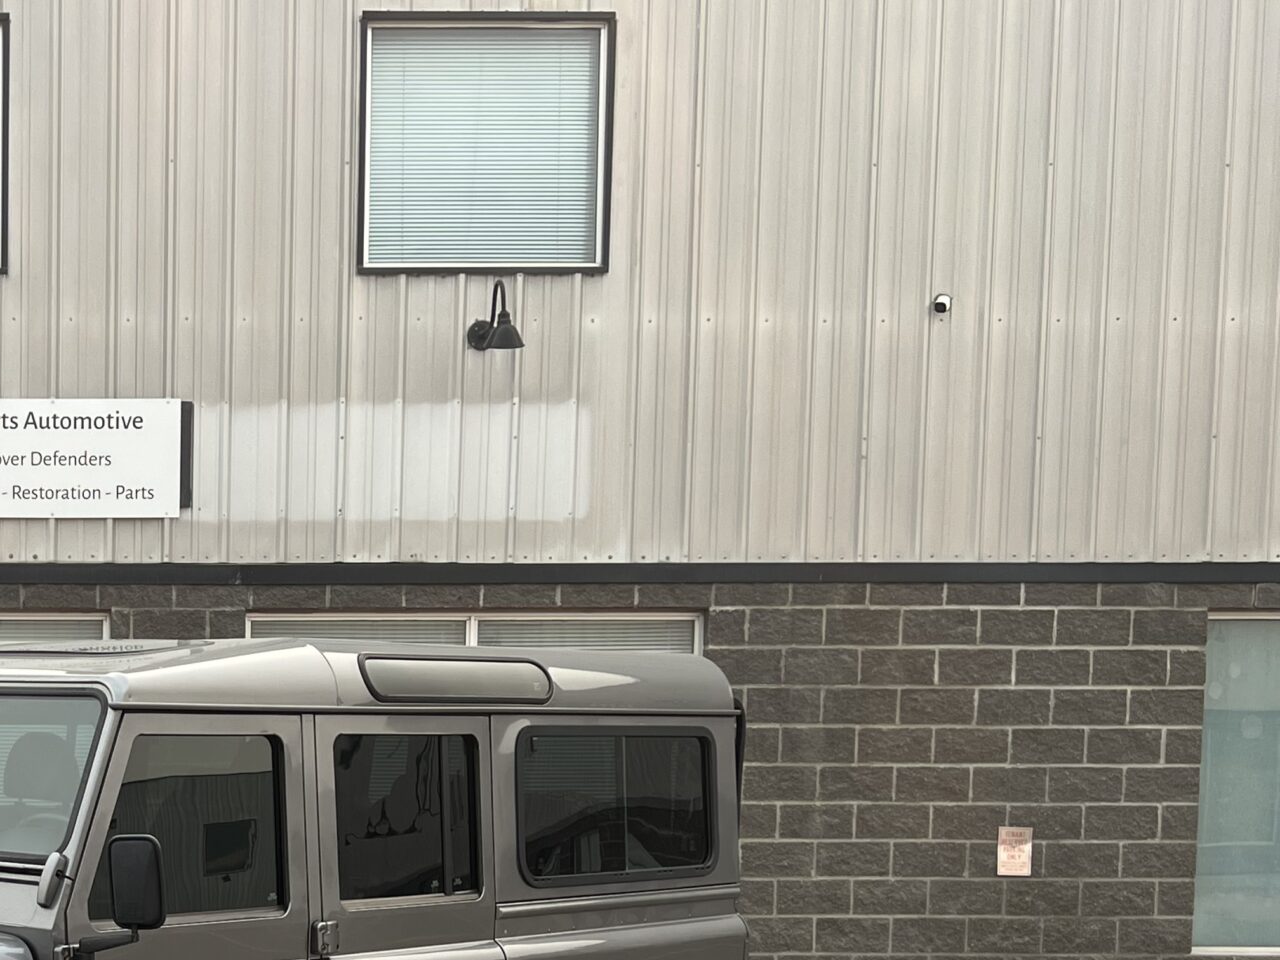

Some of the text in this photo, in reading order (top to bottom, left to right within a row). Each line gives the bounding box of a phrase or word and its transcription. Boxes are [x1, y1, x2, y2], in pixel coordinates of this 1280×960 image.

[23, 410, 144, 430] Automotive
[30, 450, 112, 467] Defenders
[12, 484, 102, 501] Restoration
[115, 484, 155, 501] Parts
